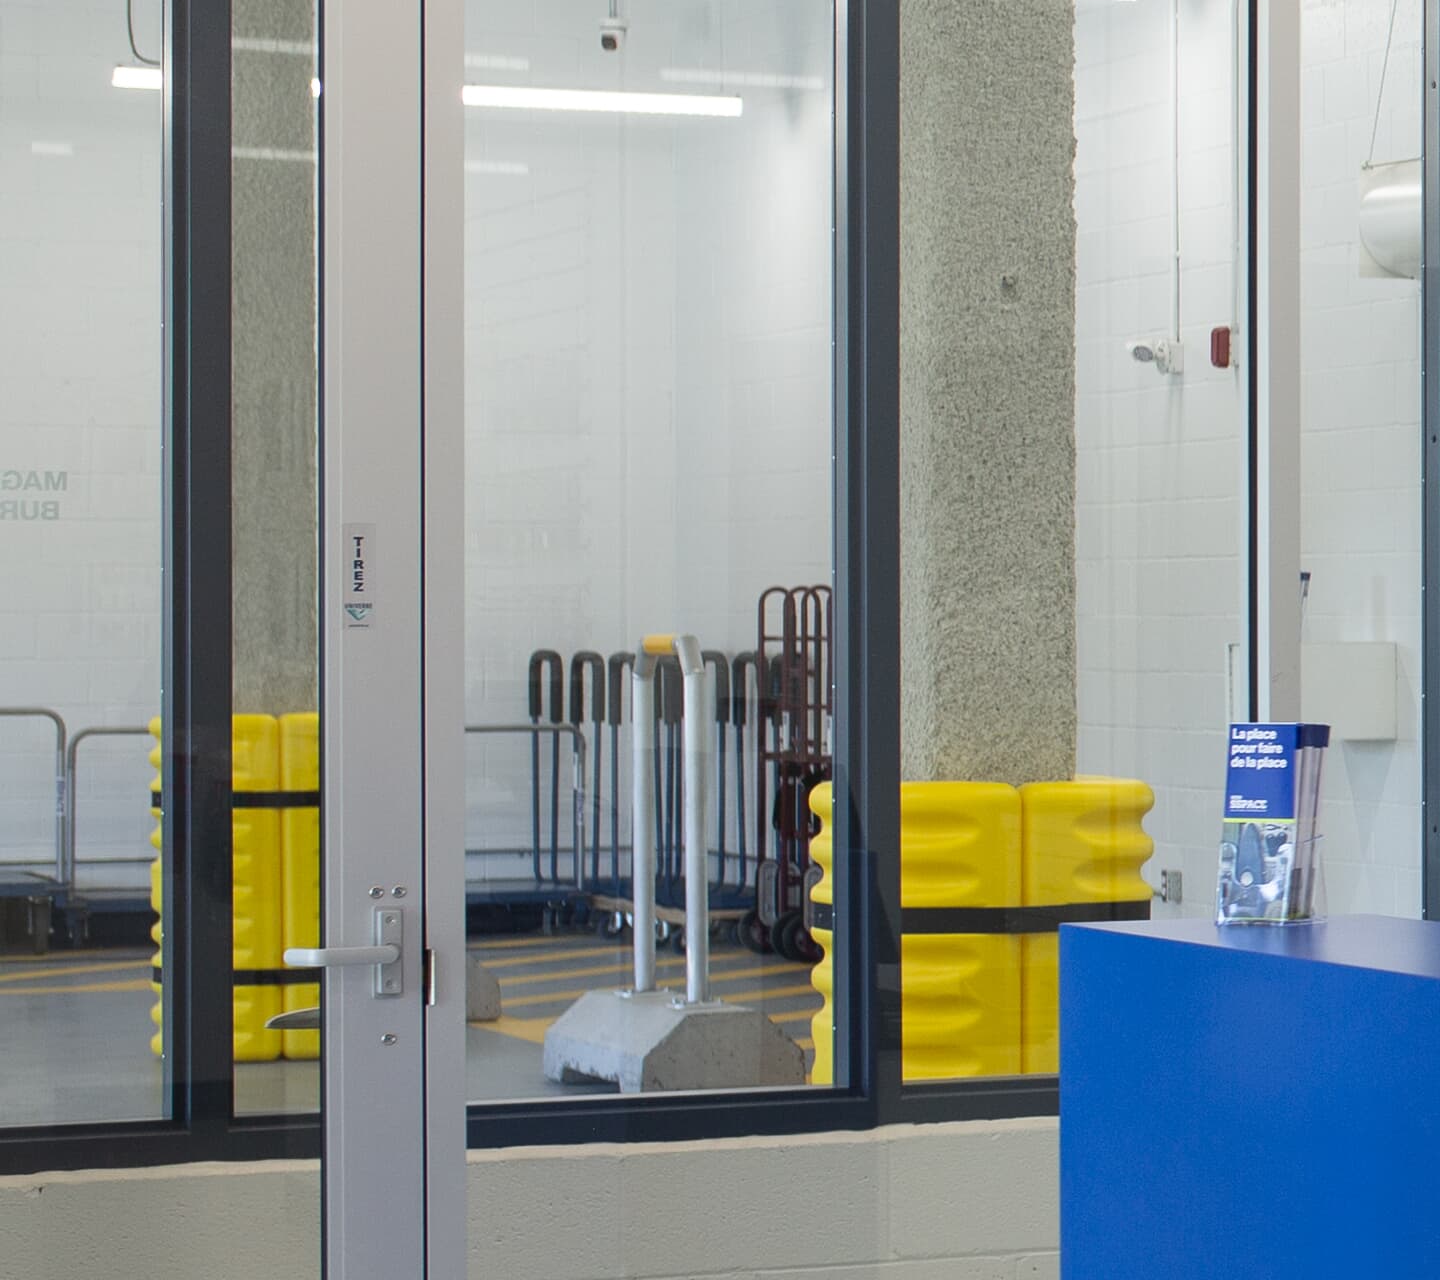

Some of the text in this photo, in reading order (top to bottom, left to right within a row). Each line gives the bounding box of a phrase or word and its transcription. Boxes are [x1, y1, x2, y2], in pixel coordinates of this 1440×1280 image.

[353, 536, 364, 592] TIREZ
[1232, 728, 1277, 741] La place
[1231, 742, 1283, 755] pour faire
[1230, 756, 1288, 770] de la place
